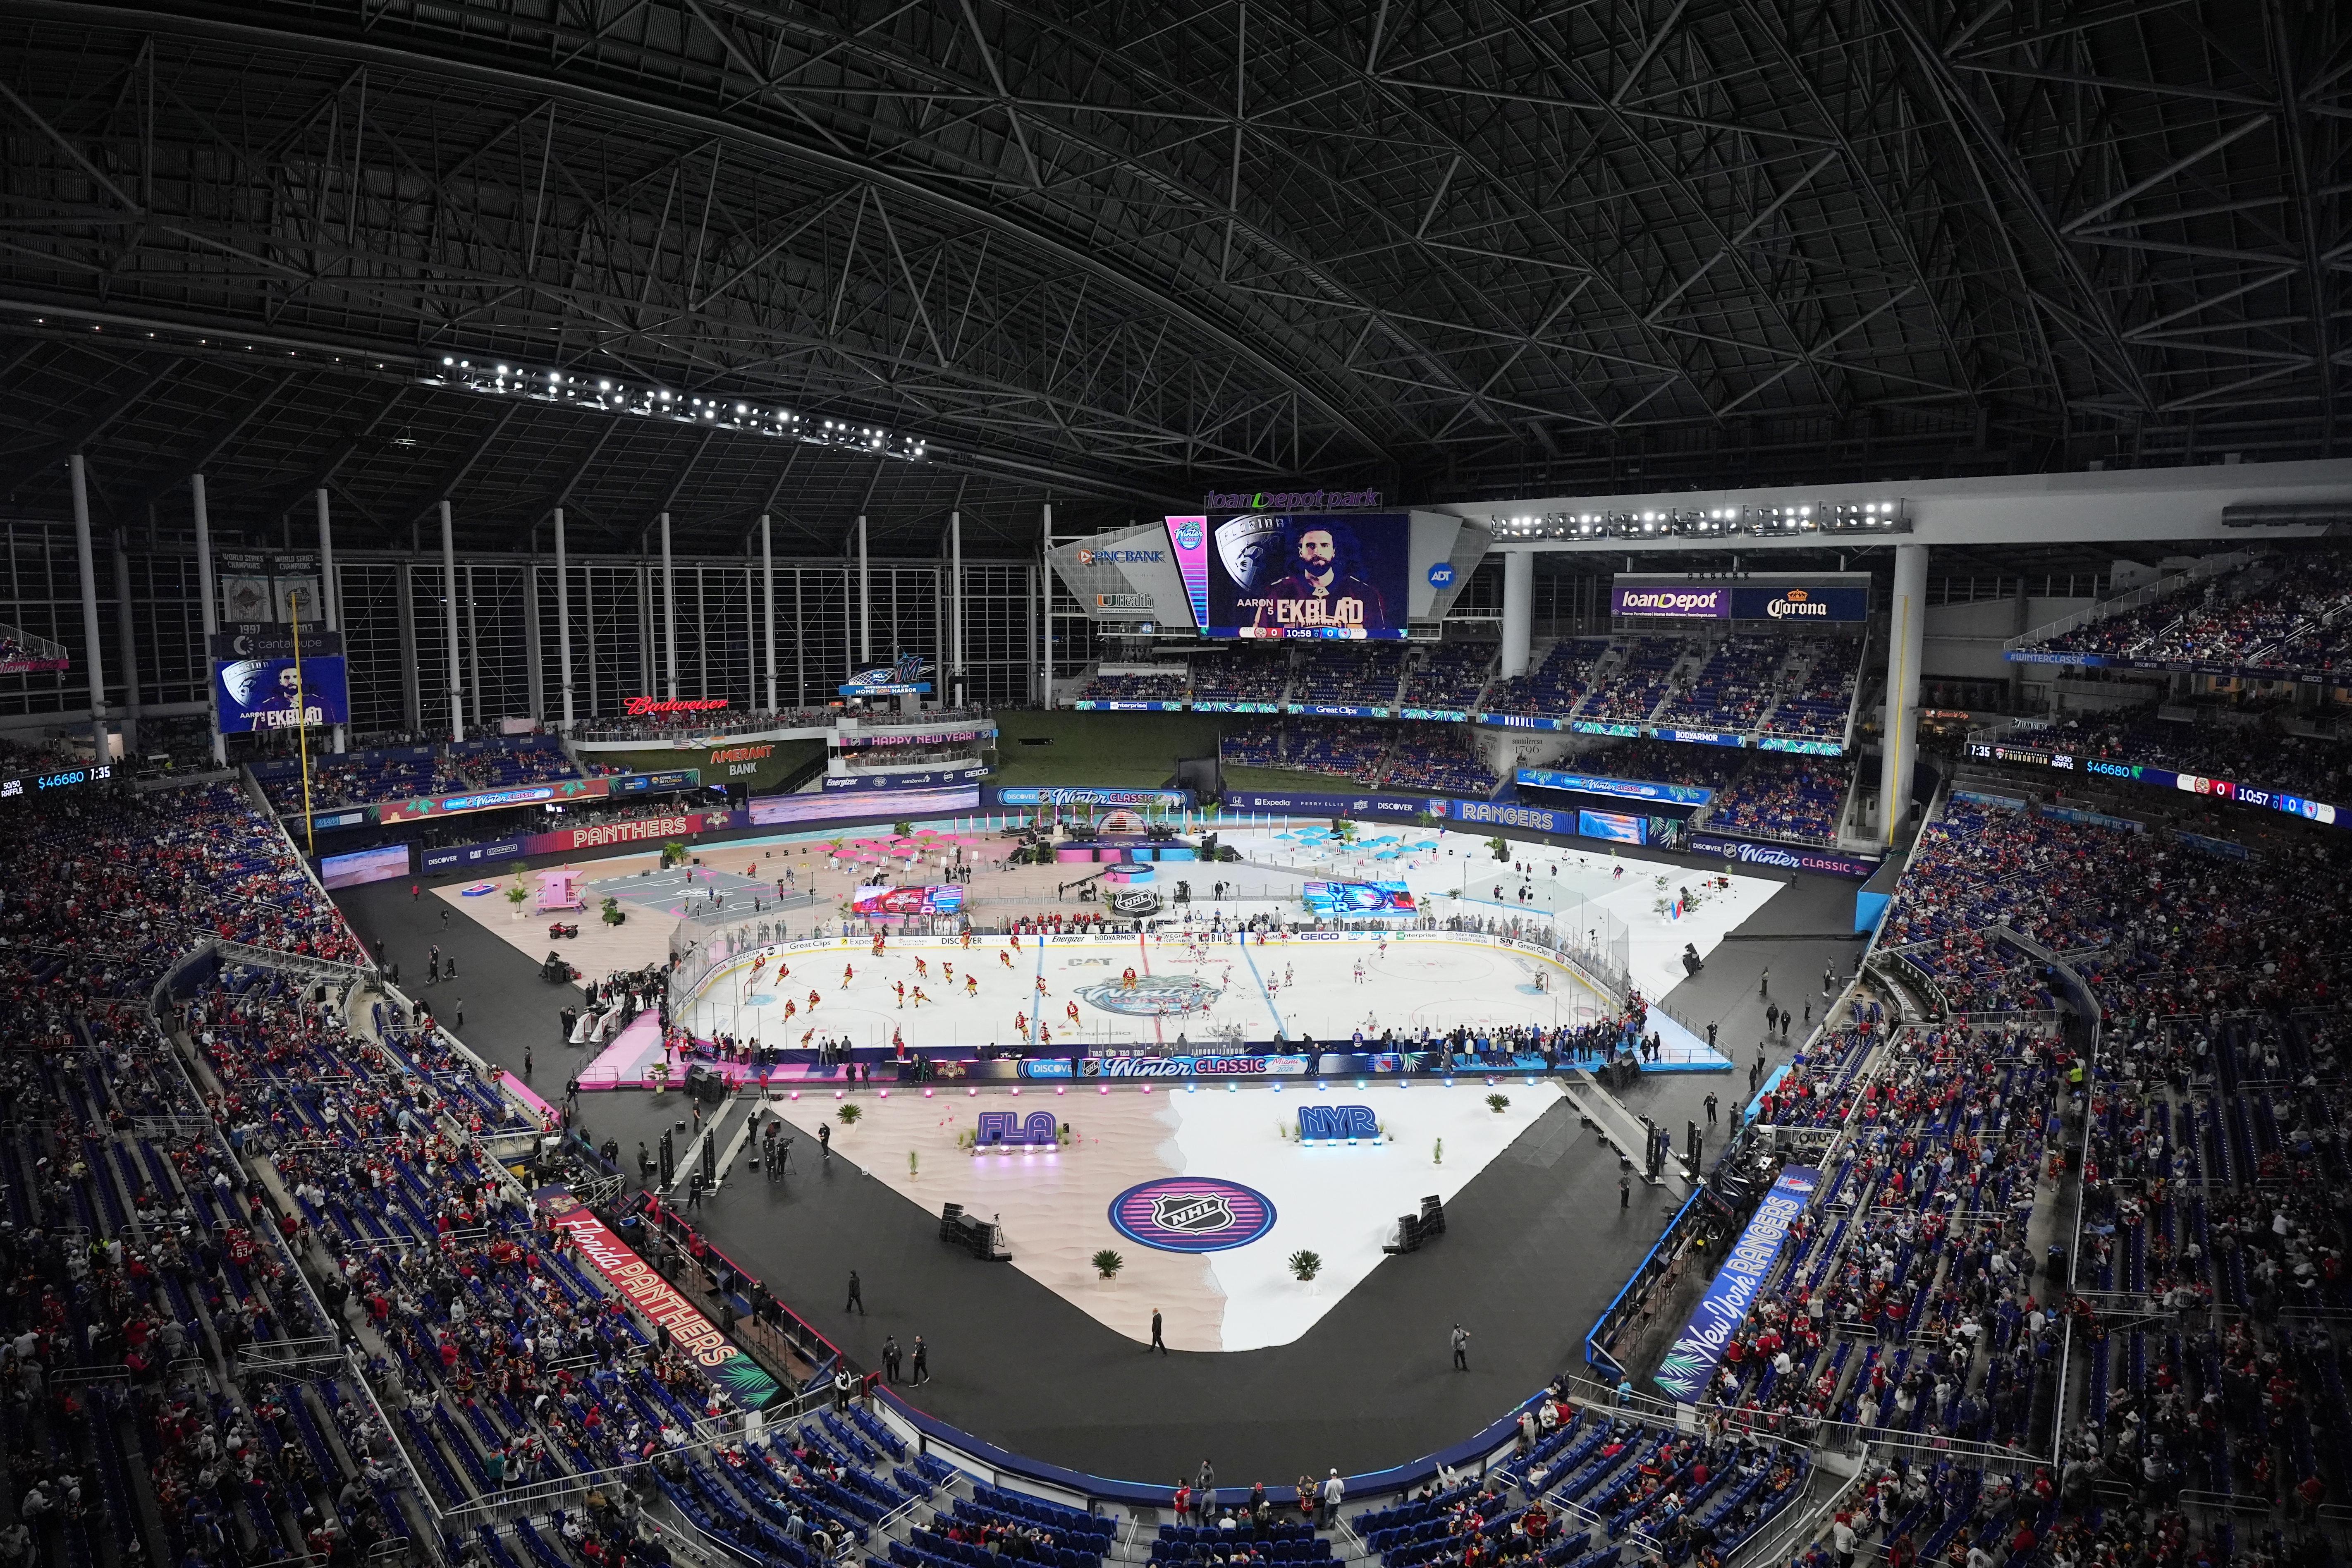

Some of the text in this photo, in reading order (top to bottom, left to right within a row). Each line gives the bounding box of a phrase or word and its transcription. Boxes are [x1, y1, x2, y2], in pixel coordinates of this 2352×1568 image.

[1327, 488, 1380, 511] park
[1174, 528, 1203, 540] Winter
[222, 553, 244, 561] WORLD
[228, 561, 261, 569] CHAMPIONS
[1430, 570, 1451, 582] ADT
[1237, 598, 1274, 607] AARON
[1622, 591, 1717, 612] loanDepot
[1267, 607, 1274, 615] 5
[1277, 597, 1364, 624] EKBLAD
[1767, 598, 1827, 619] Corona
[239, 624, 261, 635] 1997
[2010, 653, 2085, 664] #WINTERCLASSIC
[2302, 675, 2323, 683] GEICO
[624, 696, 728, 715] Budweiser
[1111, 702, 1147, 710] enterprise
[1339, 706, 1357, 715] Clips
[267, 706, 323, 727] EKBLAD
[1958, 711, 1969, 719] Up
[1504, 716, 1535, 728] NOBULL
[2034, 722, 2047, 730] STORE
[872, 732, 975, 745] HAPPY NEW YEAR!
[1675, 731, 1718, 742] BODYARMOR
[710, 745, 772, 764] AMERANT
[1971, 745, 1990, 758] 7:35
[2005, 752, 2048, 765] FOUNDATION
[2051, 760, 2074, 770] RAFFLE
[2055, 755, 2072, 763] 50/50
[90, 766, 110, 780] 7:35
[729, 762, 757, 776] BANK
[964, 768, 989, 778] GEICO
[2087, 760, 2130, 777] $46680
[3, 780, 21, 790] 50/50
[38, 771, 84, 790] $46680
[827, 778, 858, 787] Energizer
[1587, 779, 1616, 791] Winter
[1617, 784, 1641, 793] CLASSIC
[1, 786, 23, 798] RAFFLE
[2216, 783, 2225, 795] 0
[474, 794, 507, 808] Winter
[1052, 788, 1108, 804] Winter
[2239, 788, 2269, 806] 10:57
[1377, 802, 1413, 811] DISCOVER
[2288, 799, 2297, 812] 0
[1463, 803, 1554, 830] RANGERS
[573, 817, 687, 848] PANTHERS
[428, 855, 457, 866] DISCOVER
[469, 849, 482, 859] CAT
[1692, 843, 1851, 873] DISCOVER Winter CLASSIC
[1124, 894, 1147, 907] NHL
[1052, 935, 1085, 943] Energizer
[1348, 932, 1362, 940] SAP
[1499, 937, 1513, 945] SN
[790, 941, 812, 950] Great
[1518, 941, 1550, 956] Great Clips
[728, 950, 760, 964] NORWEGIAN
[1068, 958, 1112, 966] CAT
[708, 963, 727, 980] HONDA
[1574, 965, 1591, 983] DISCOVER
[696, 977, 709, 994] verizon
[1085, 1058, 1267, 1077] NHL Winter CLASSIC
[978, 1112, 1056, 1143] FLA
[1298, 1107, 1378, 1138] NYR
[1171, 1203, 1216, 1226] NHL
[1726, 1196, 1800, 1277] RANGERS
[555, 1218, 739, 1367] Florida PANTHERS
[1703, 1272, 1757, 1320] York
[1685, 1316, 1733, 1364] New
